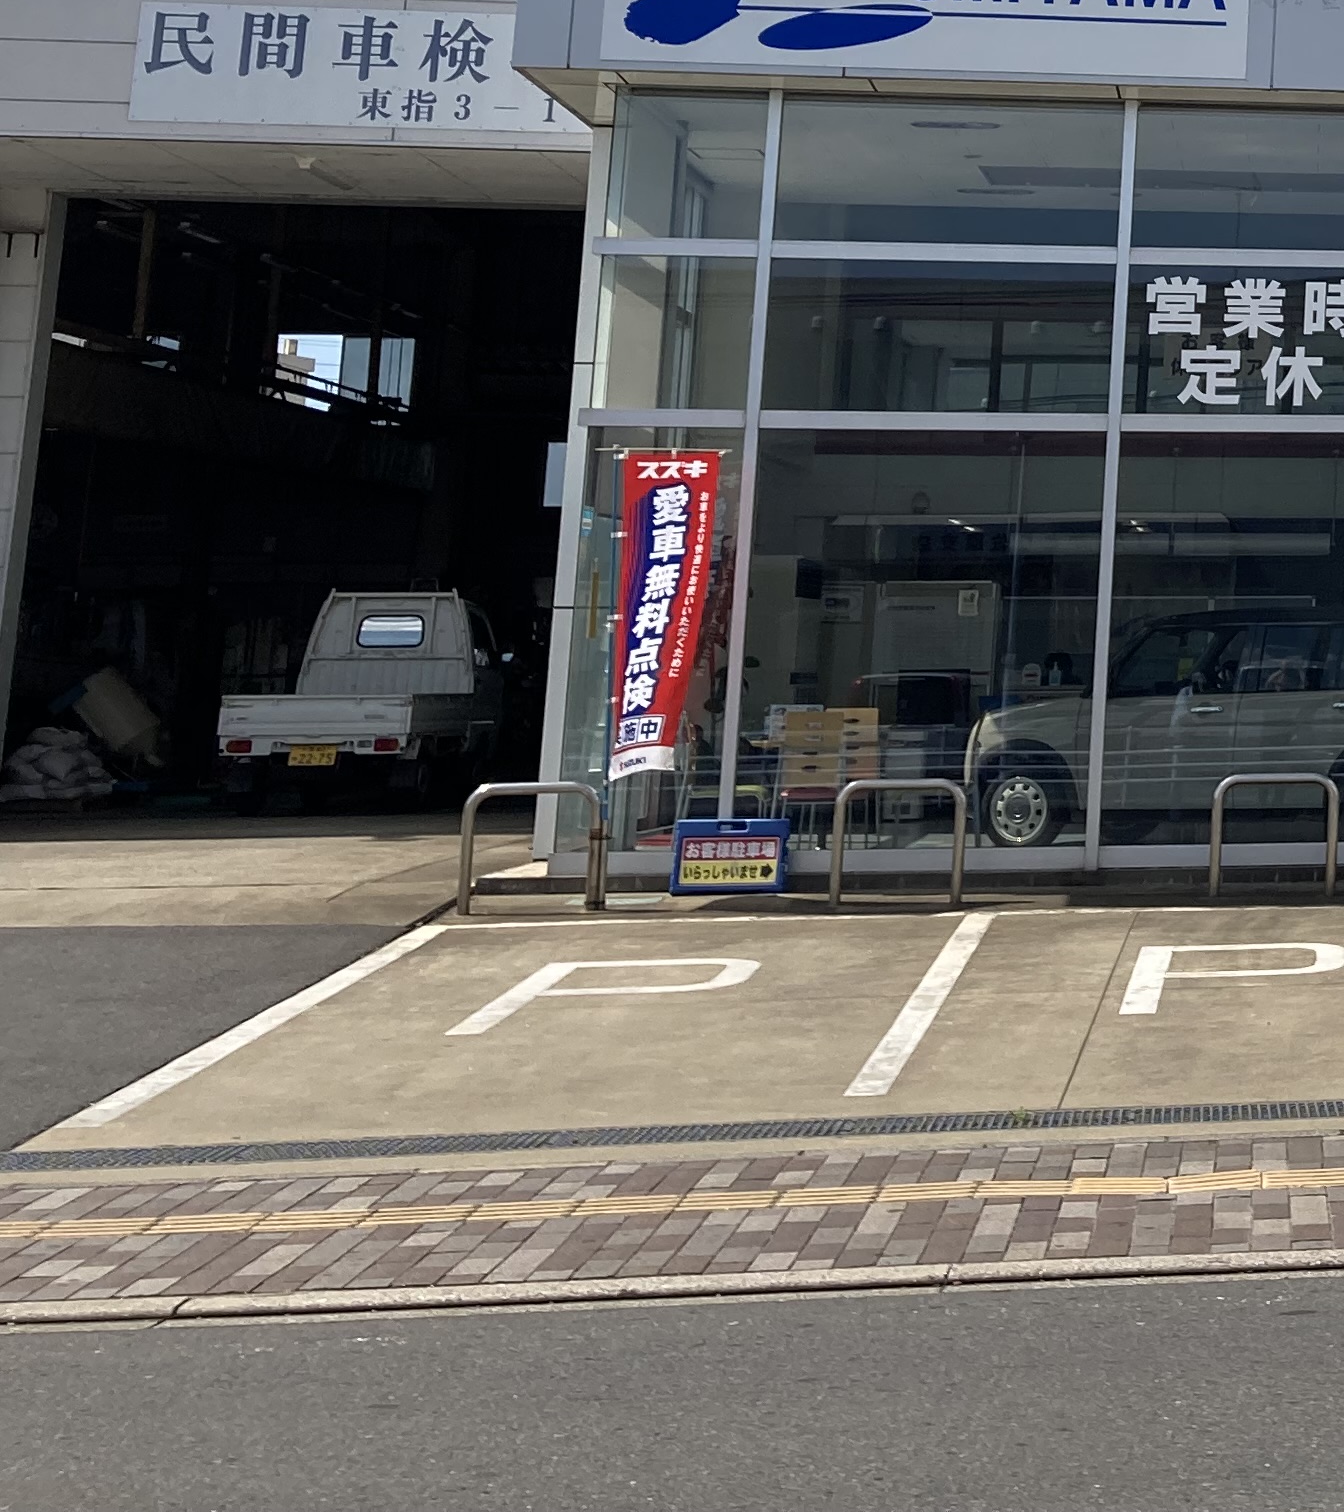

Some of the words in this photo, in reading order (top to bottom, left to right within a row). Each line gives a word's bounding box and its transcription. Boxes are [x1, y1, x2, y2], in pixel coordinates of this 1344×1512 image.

[143, 11, 495, 84] 民間車検
[636, 459, 708, 480] スズキ
[621, 484, 690, 715] 愛車無料点検
[617, 719, 659, 746] 施中
[685, 841, 776, 858] お客様駐車場
[683, 865, 758, 879] いらっしゃいませ
[446, 958, 762, 1037] P
